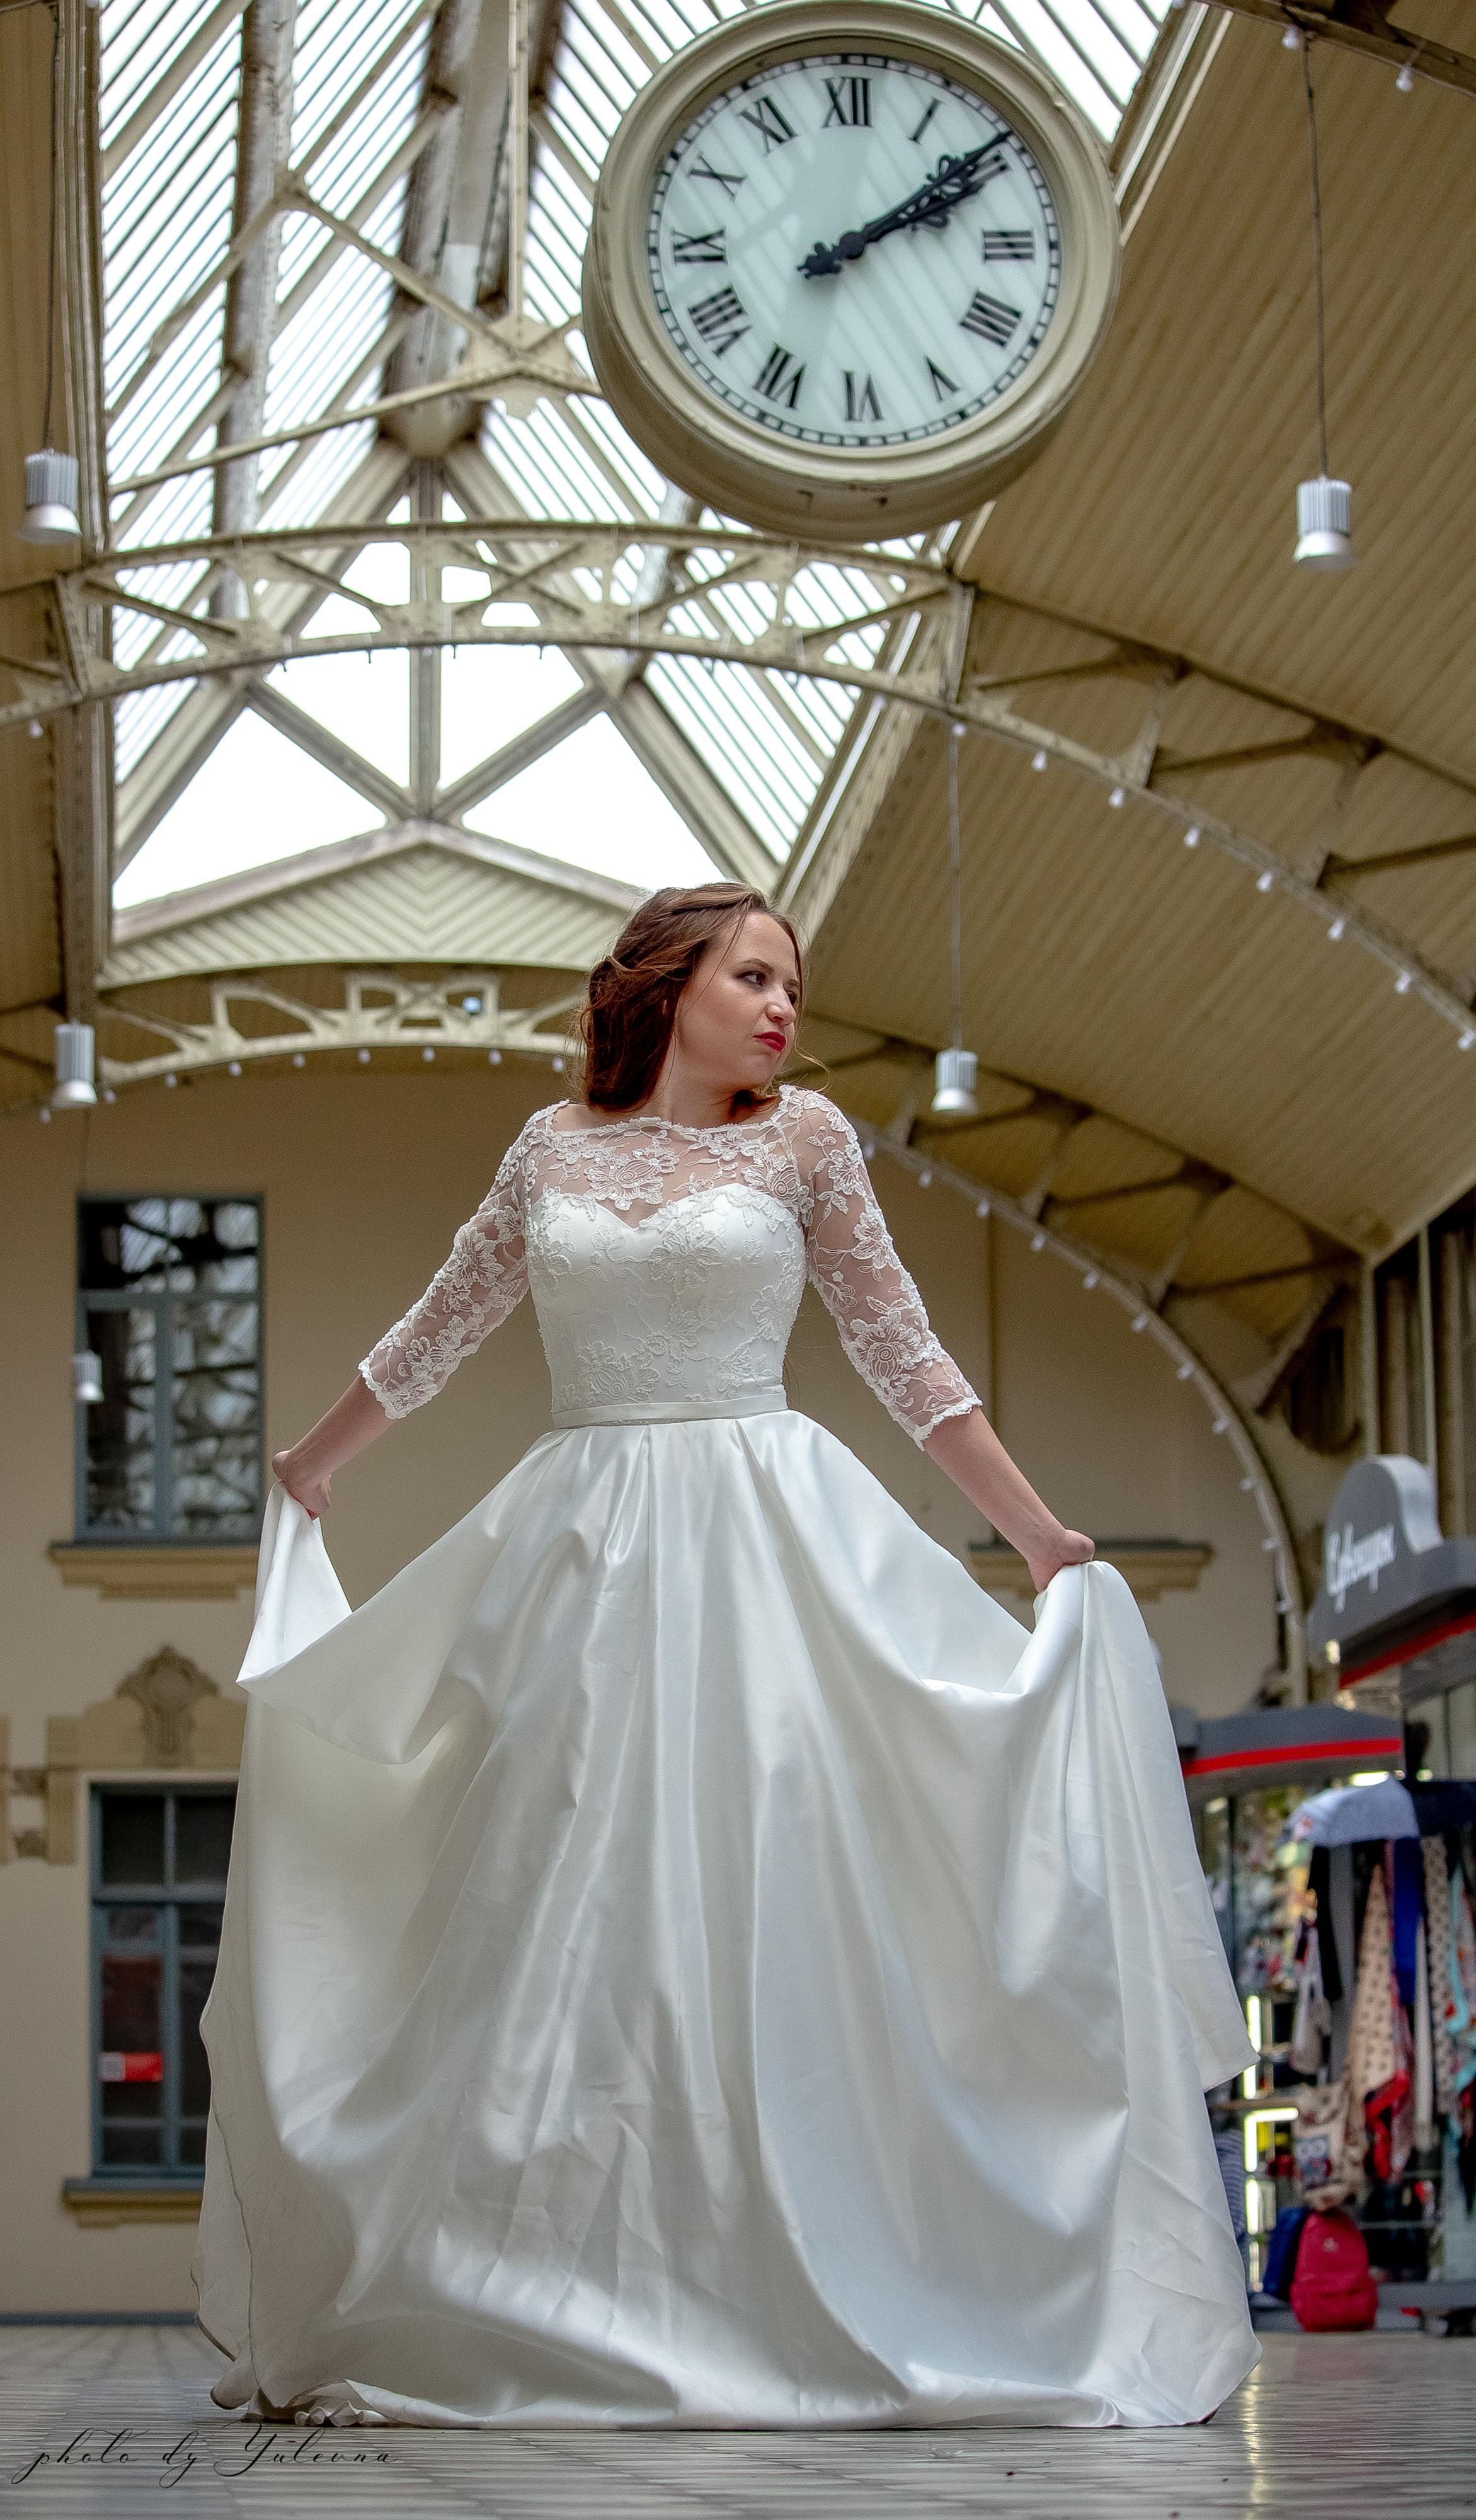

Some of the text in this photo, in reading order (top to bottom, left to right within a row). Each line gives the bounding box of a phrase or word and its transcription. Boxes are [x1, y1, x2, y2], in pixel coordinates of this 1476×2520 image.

[738, 94, 799, 156] XI
[822, 76, 873, 127] XII
[909, 98, 944, 147] I
[688, 150, 748, 198] X
[672, 228, 728, 265] IX
[982, 228, 1034, 263] III
[687, 282, 752, 357] VIII
[959, 288, 1023, 348] IIII
[752, 341, 807, 410] VII
[842, 370, 884, 422] VI
[925, 354, 960, 402] V
